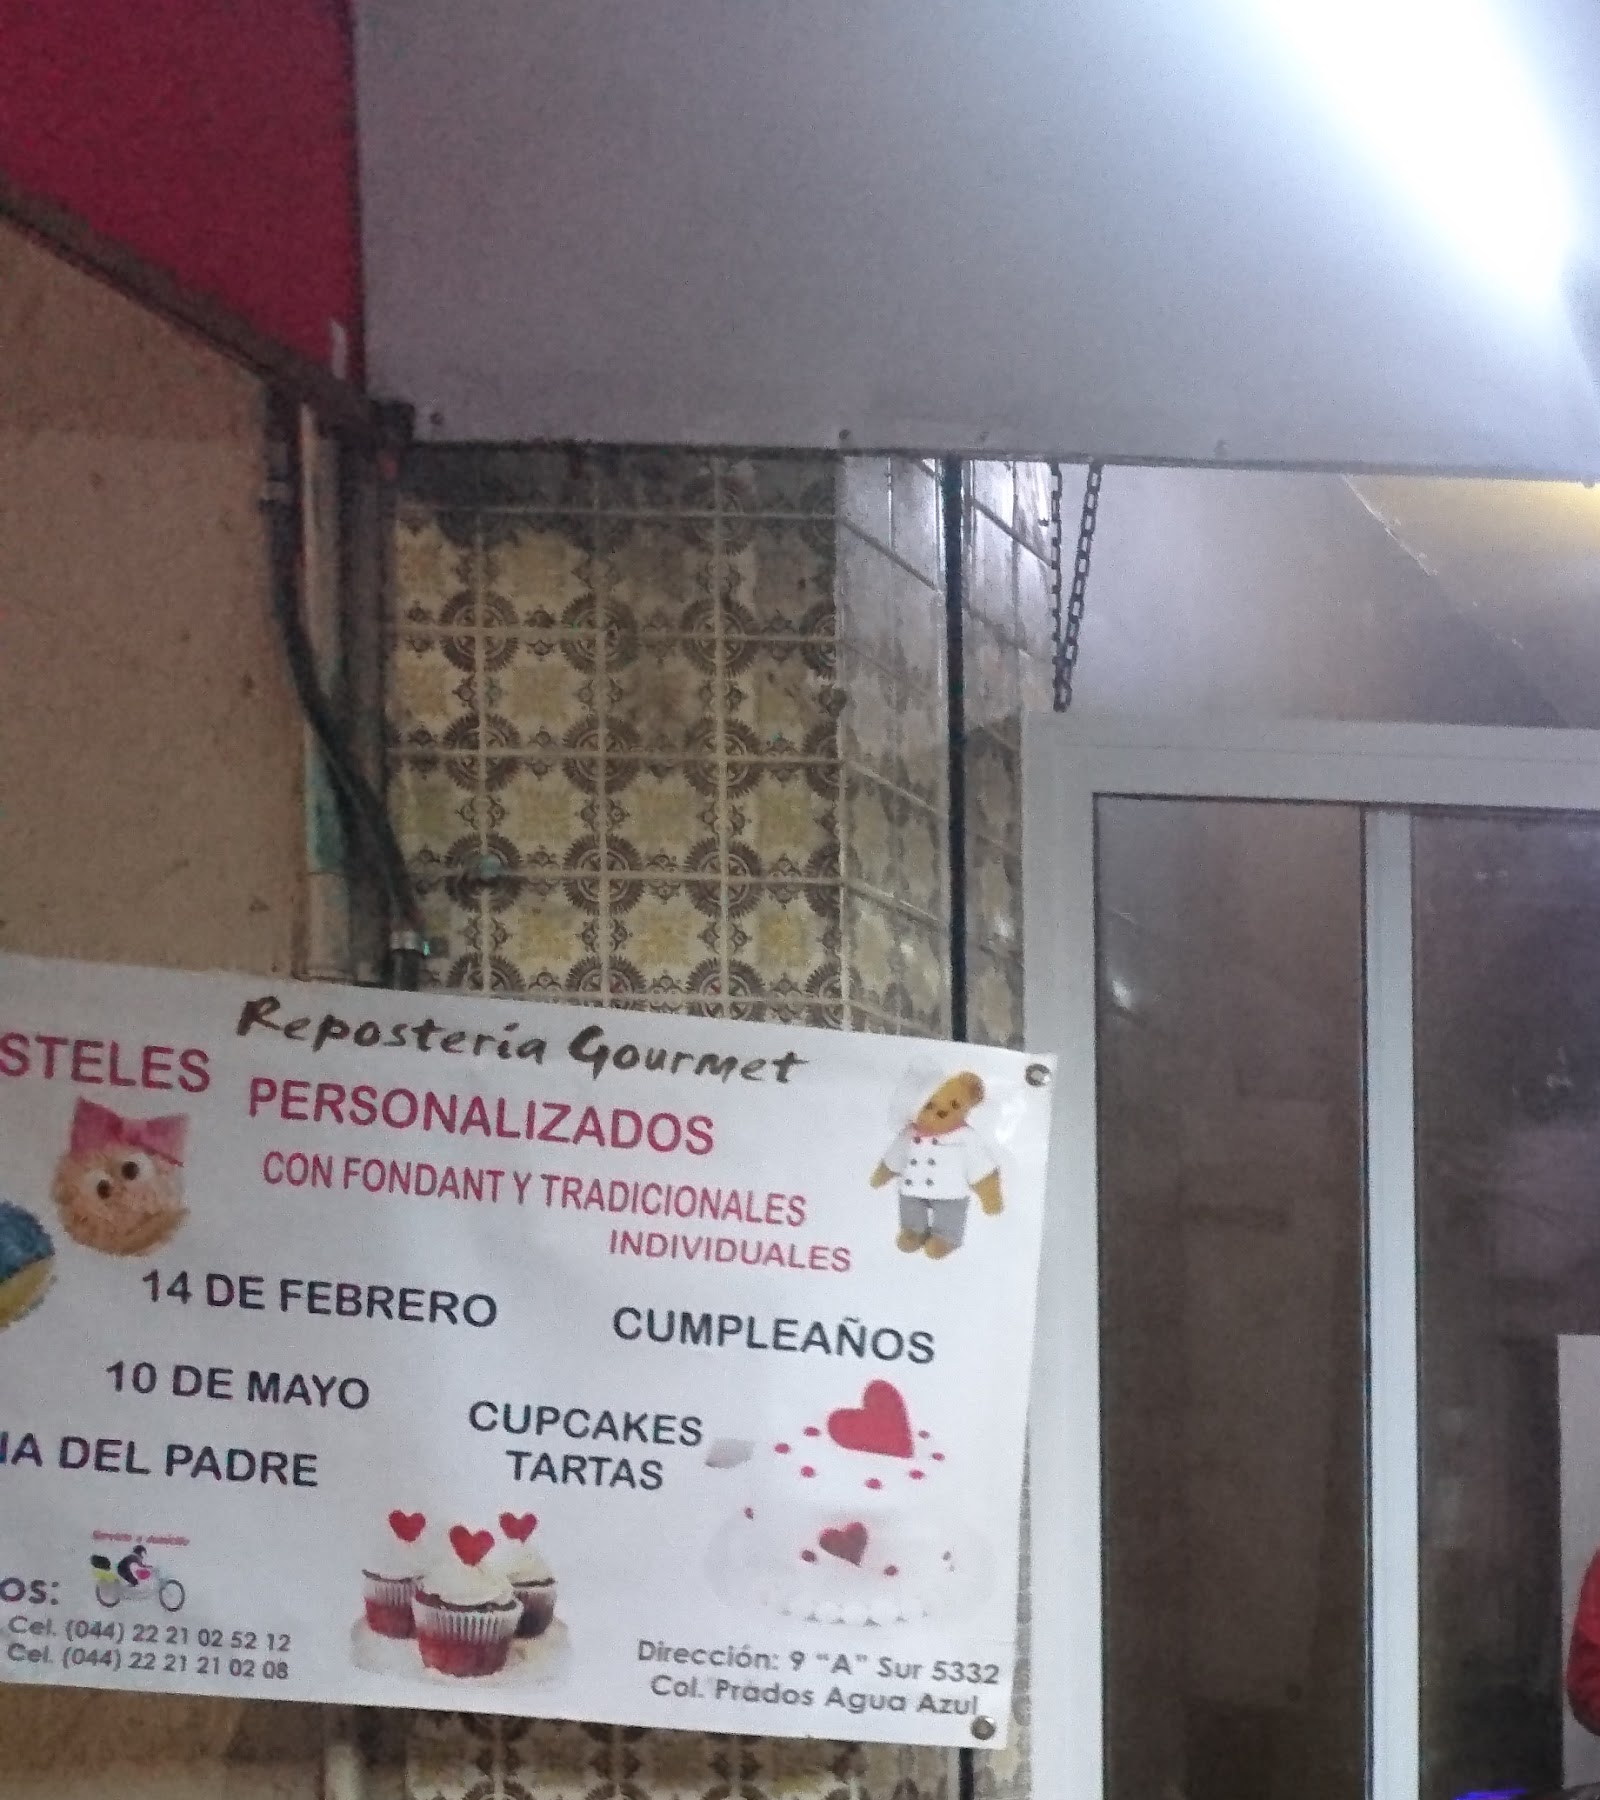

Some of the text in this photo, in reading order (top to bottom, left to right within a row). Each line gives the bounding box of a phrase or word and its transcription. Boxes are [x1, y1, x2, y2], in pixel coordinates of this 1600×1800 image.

[568, 1024, 808, 1084] Gourmet
[249, 1077, 714, 1155] PERSONALIZADOS
[263, 1151, 808, 1227] CON FONDANT Y TRADICIONALES
[610, 1230, 852, 1272] INDIVIDUALES
[142, 1269, 498, 1328] 14 DE FEBRERO
[613, 1305, 935, 1364] CUMPLEAÑOS
[105, 1361, 370, 1410] 10 DE MAYO
[469, 1401, 703, 1447] CUPCAKES
[58, 1437, 151, 1476] DEL
[165, 1444, 318, 1487] PADRE
[506, 1449, 664, 1490] TARTAS
[8, 1615, 292, 1652] Cel. (044) 22 21 02 52 12
[7, 1642, 289, 1680] Cel. (044) 22 21 21 02 08
[637, 1639, 779, 1671] Dirección:
[788, 1650, 805, 1671] 9
[877, 1656, 923, 1680] Sur
[931, 1660, 1000, 1685] 5332
[650, 1674, 978, 1716] Col. Prados Agua Azul
